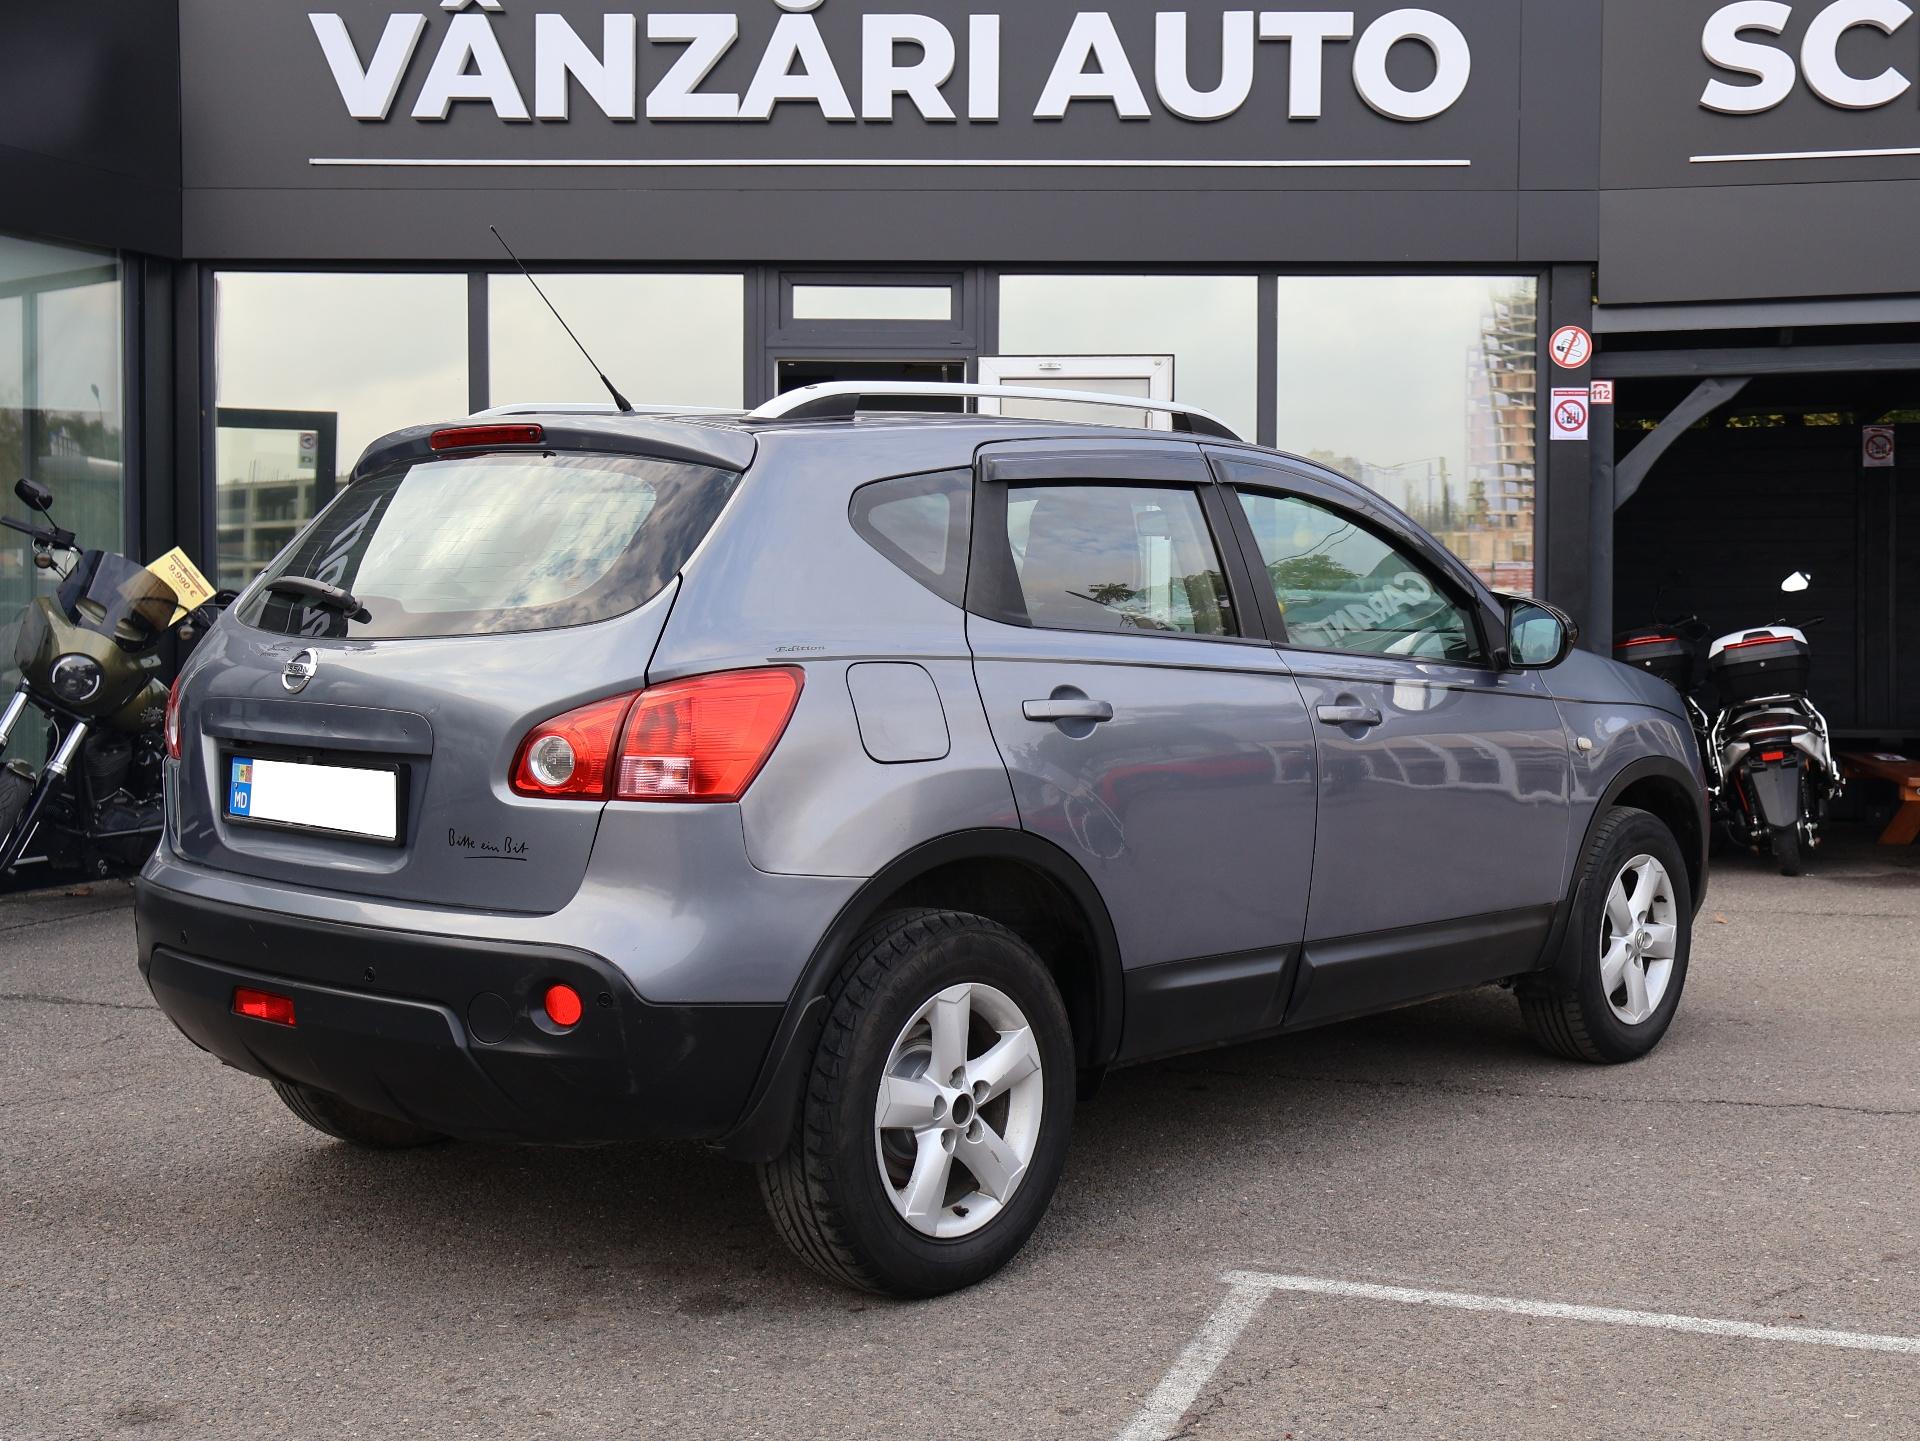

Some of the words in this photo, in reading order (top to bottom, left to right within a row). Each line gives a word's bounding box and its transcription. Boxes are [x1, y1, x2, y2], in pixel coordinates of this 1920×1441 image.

[307, 0, 1000, 121] VÂNZĂRI
[1032, 8, 1471, 121] AUTO
[1699, 0, 1920, 114] SC
[1591, 389, 1611, 400] 112
[169, 564, 191, 589] 9.990
[234, 791, 248, 809] MD
[448, 827, 476, 849] Bitte
[481, 841, 500, 853] ein
[504, 836, 529, 854] Bit
